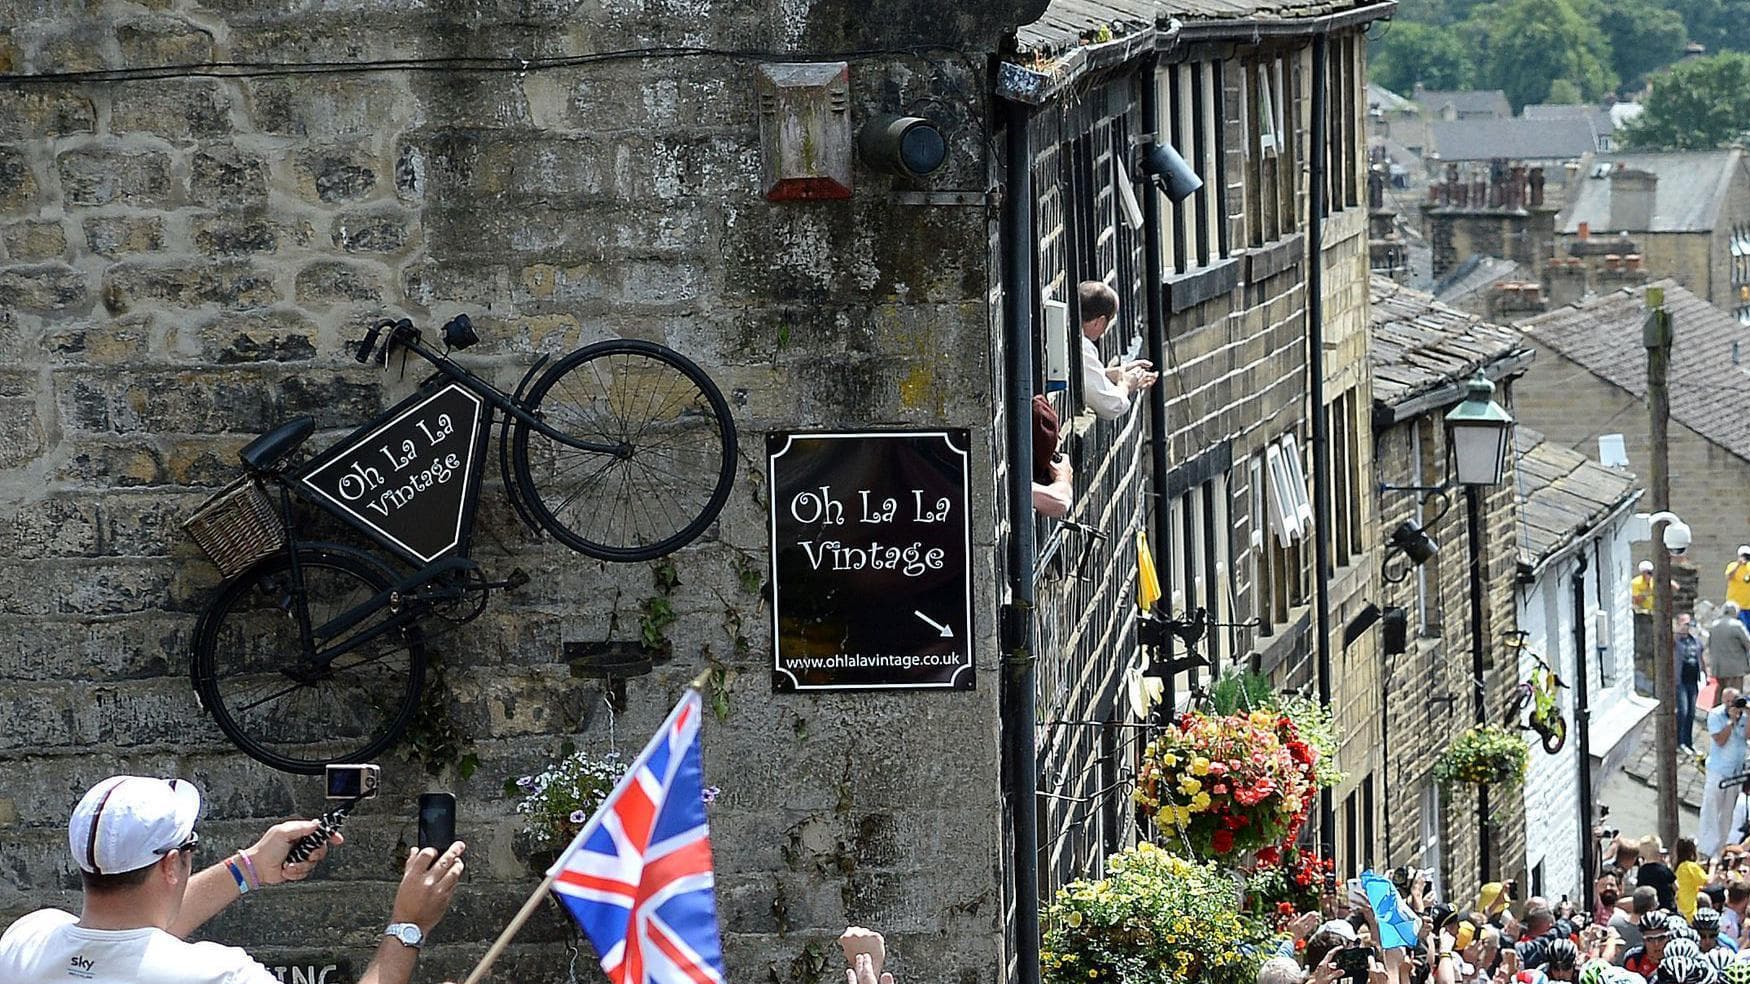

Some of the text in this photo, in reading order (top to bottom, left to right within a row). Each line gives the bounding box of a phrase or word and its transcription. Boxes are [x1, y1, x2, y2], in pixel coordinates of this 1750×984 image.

[338, 413, 455, 500] Oh La La
[366, 453, 461, 517] Vintage
[791, 485, 951, 525] Oh La La
[797, 541, 945, 576] Vintage
[786, 652, 961, 670] www.ohlalavintage.co.uk
[71, 955, 95, 971] sky
